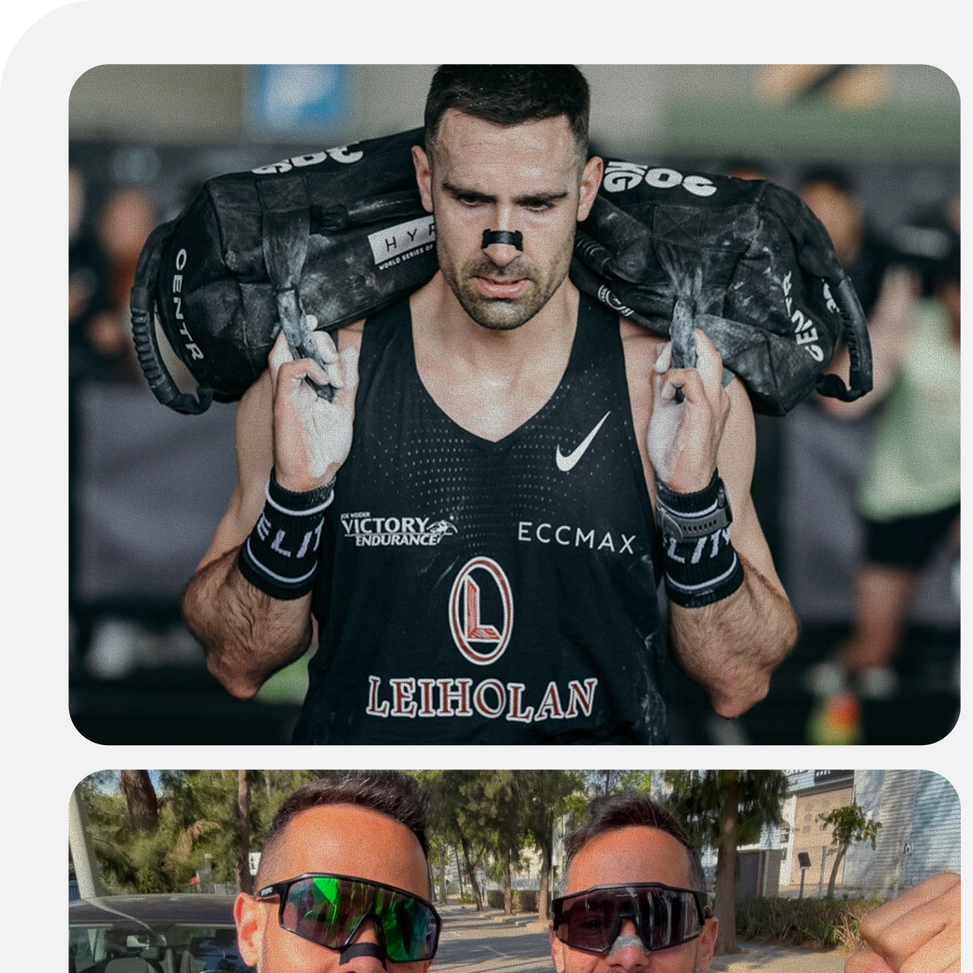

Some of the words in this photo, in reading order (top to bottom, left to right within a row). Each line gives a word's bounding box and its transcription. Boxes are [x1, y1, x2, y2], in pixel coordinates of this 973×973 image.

[172, 248, 205, 360] CENTR
[341, 517, 430, 534] VICTORY
[355, 534, 437, 547] ENDURANCE
[518, 521, 636, 554] ECCMAX
[366, 676, 598, 723] LEIHOLAN
